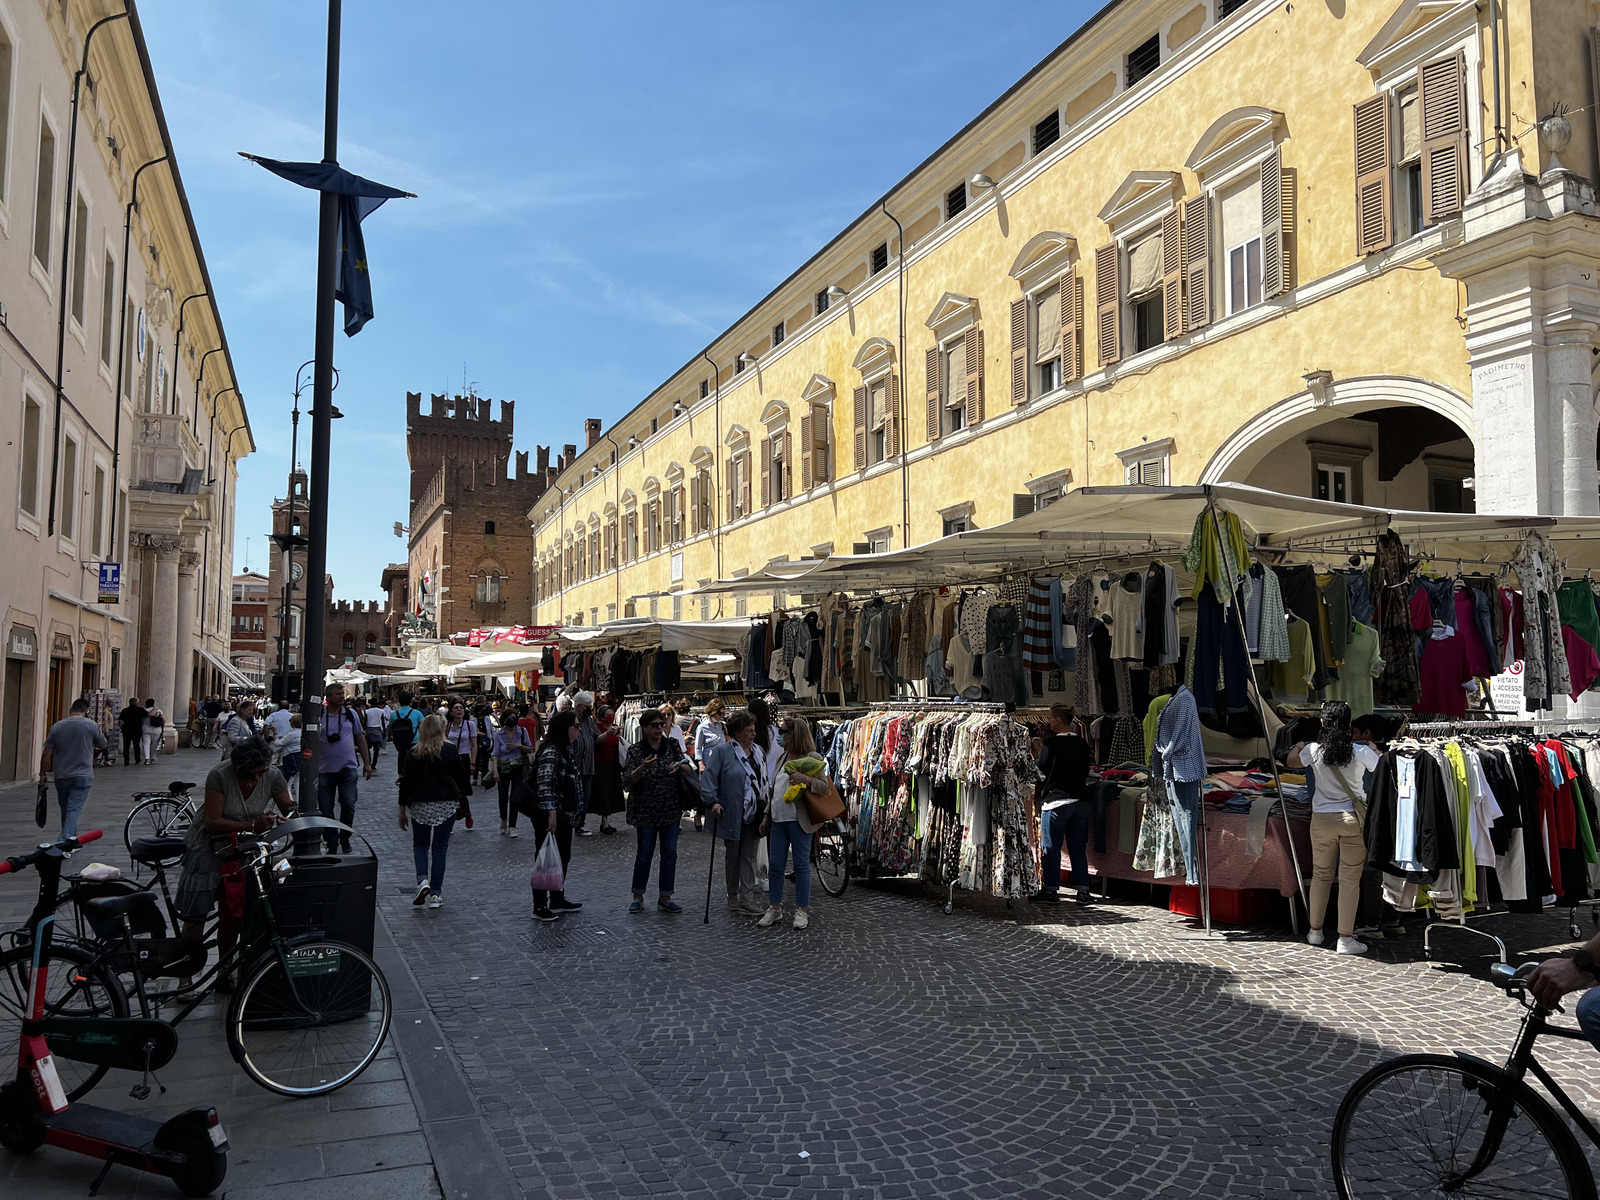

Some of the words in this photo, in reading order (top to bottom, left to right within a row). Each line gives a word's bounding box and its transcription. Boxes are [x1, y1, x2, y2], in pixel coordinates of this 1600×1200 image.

[1478, 363, 1525, 380] PADIMETRO
[102, 565, 117, 581] T
[1493, 684, 1522, 692] L'ACCESSO
